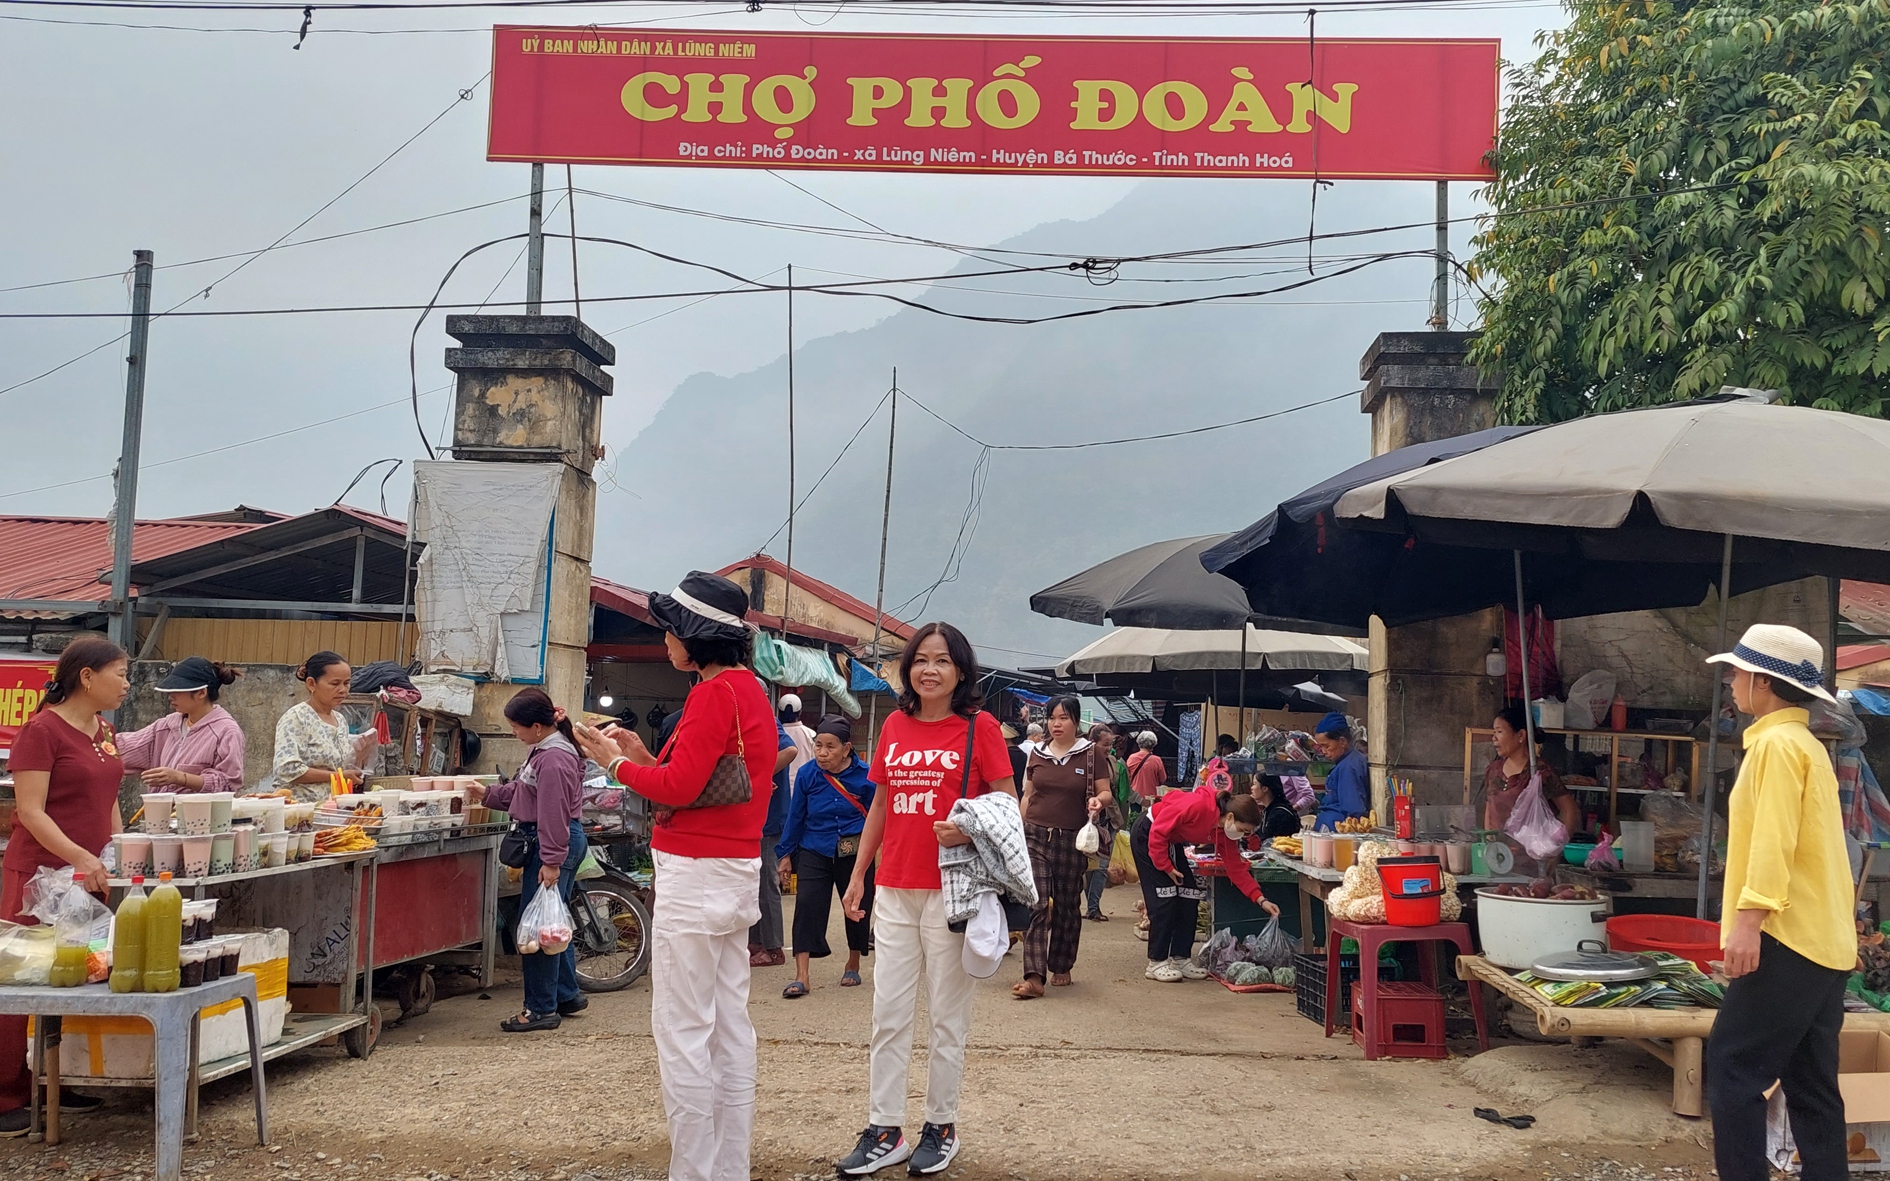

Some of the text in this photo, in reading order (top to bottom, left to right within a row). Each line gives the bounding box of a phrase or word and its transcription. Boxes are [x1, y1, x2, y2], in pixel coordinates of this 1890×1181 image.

[522, 34, 756, 57] UỶ BAN NHÂN DÂN XÃ LŨNG NIÊM
[620, 54, 1360, 139] CHỢ PHỐ ĐOÀN
[678, 142, 709, 160] Địa
[713, 141, 746, 158] chỉ:
[751, 142, 787, 159] Phố
[790, 144, 838, 160] Đoàn
[853, 146, 877, 161] xã
[882, 146, 924, 166] Lũng
[930, 147, 976, 163] Niêm
[991, 148, 1048, 168] Huyện
[1053, 149, 1077, 165] Bá
[1082, 149, 1137, 166] Thước
[1152, 150, 1189, 166] Tỉnh
[1194, 152, 1249, 168] Thanh
[1255, 152, 1293, 168] Hoá
[885, 742, 960, 769] Love
[887, 769, 893, 777] is
[909, 770, 944, 778] greatest
[893, 789, 937, 815] art
